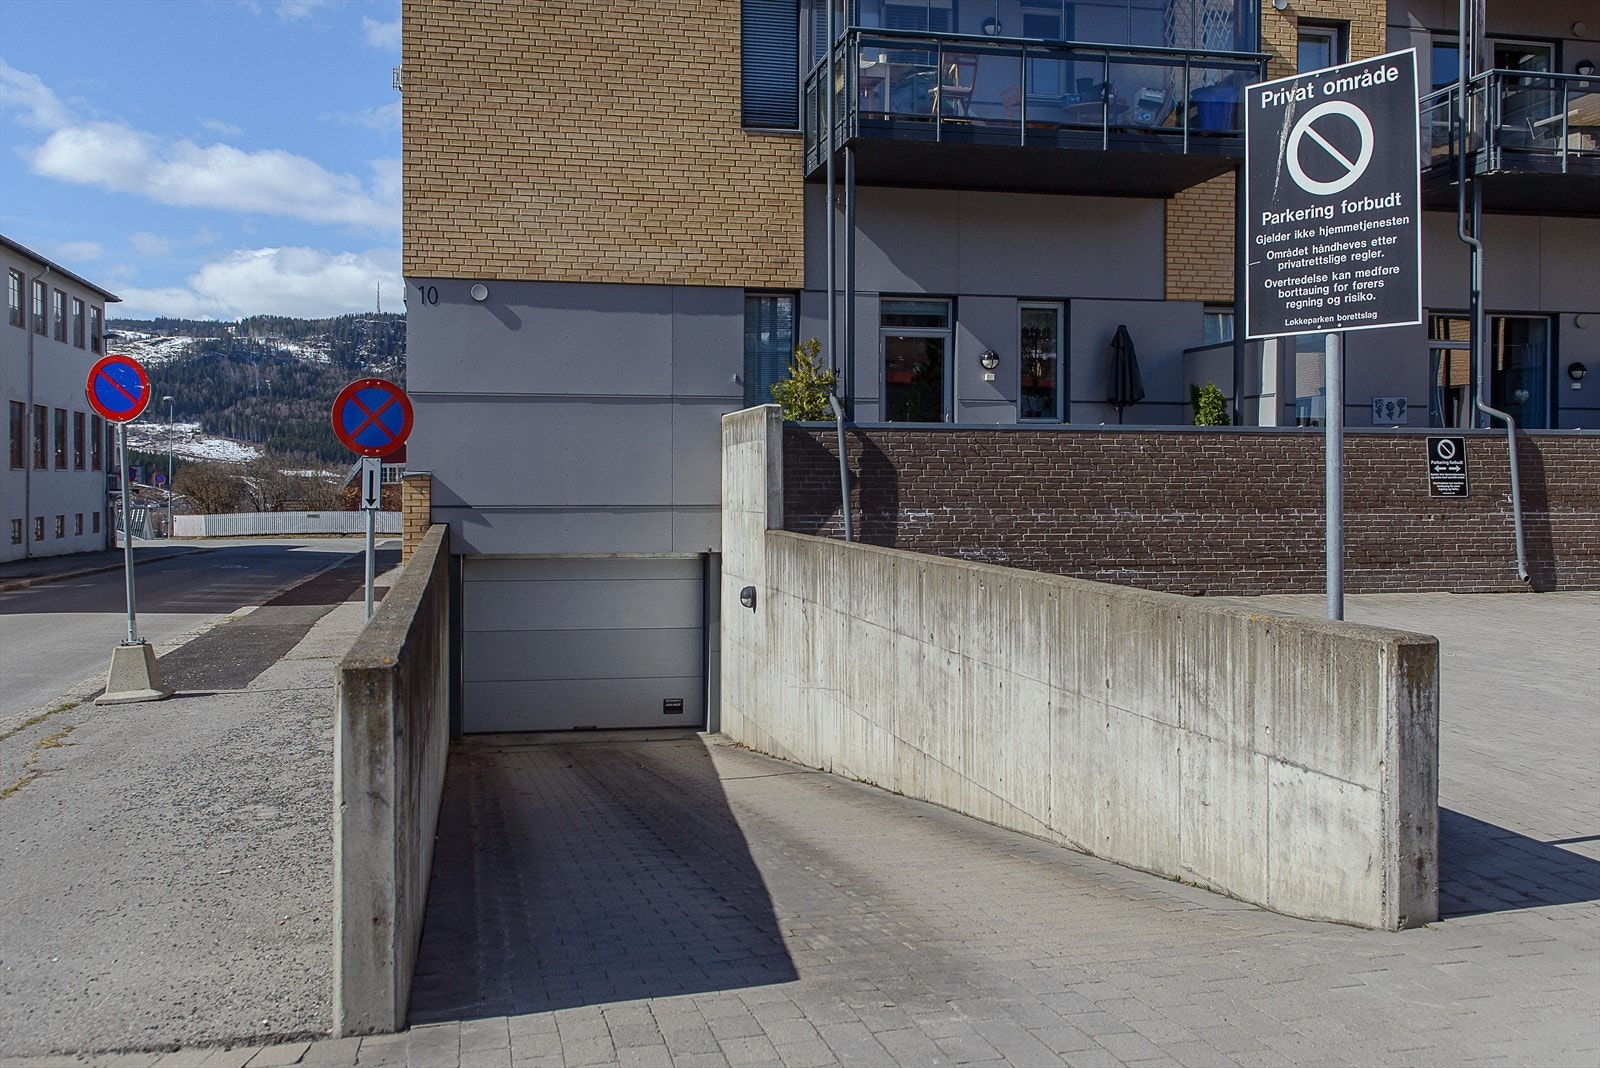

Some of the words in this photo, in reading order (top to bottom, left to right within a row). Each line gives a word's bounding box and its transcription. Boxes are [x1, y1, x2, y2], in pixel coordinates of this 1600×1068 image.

[1261, 82, 1315, 109] Privat
[1323, 65, 1399, 95] område
[1262, 203, 1334, 225] Parkering
[1341, 193, 1402, 214] forbudt
[1256, 232, 1291, 245] Gjelder
[1295, 228, 1315, 240] ikke
[1320, 216, 1409, 236] hjemmetjenesten
[1266, 247, 1308, 260] Området
[1312, 239, 1367, 254] håndheves
[1371, 236, 1397, 246] etter
[1278, 254, 1347, 271] privatrettslige
[1351, 249, 1384, 262] regler.
[1265, 274, 1328, 288] Overtredelse
[1332, 271, 1351, 281] kan
[1355, 265, 1399, 278] medføre
[418, 285, 439, 305] 10
[1278, 285, 1329, 298] borttauing
[1333, 282, 1348, 292] for
[1352, 279, 1384, 290] førers
[1286, 297, 1323, 309] regning
[1327, 295, 1340, 305] og
[1345, 292, 1376, 302] risiko.
[1337, 311, 1377, 320] borettslag
